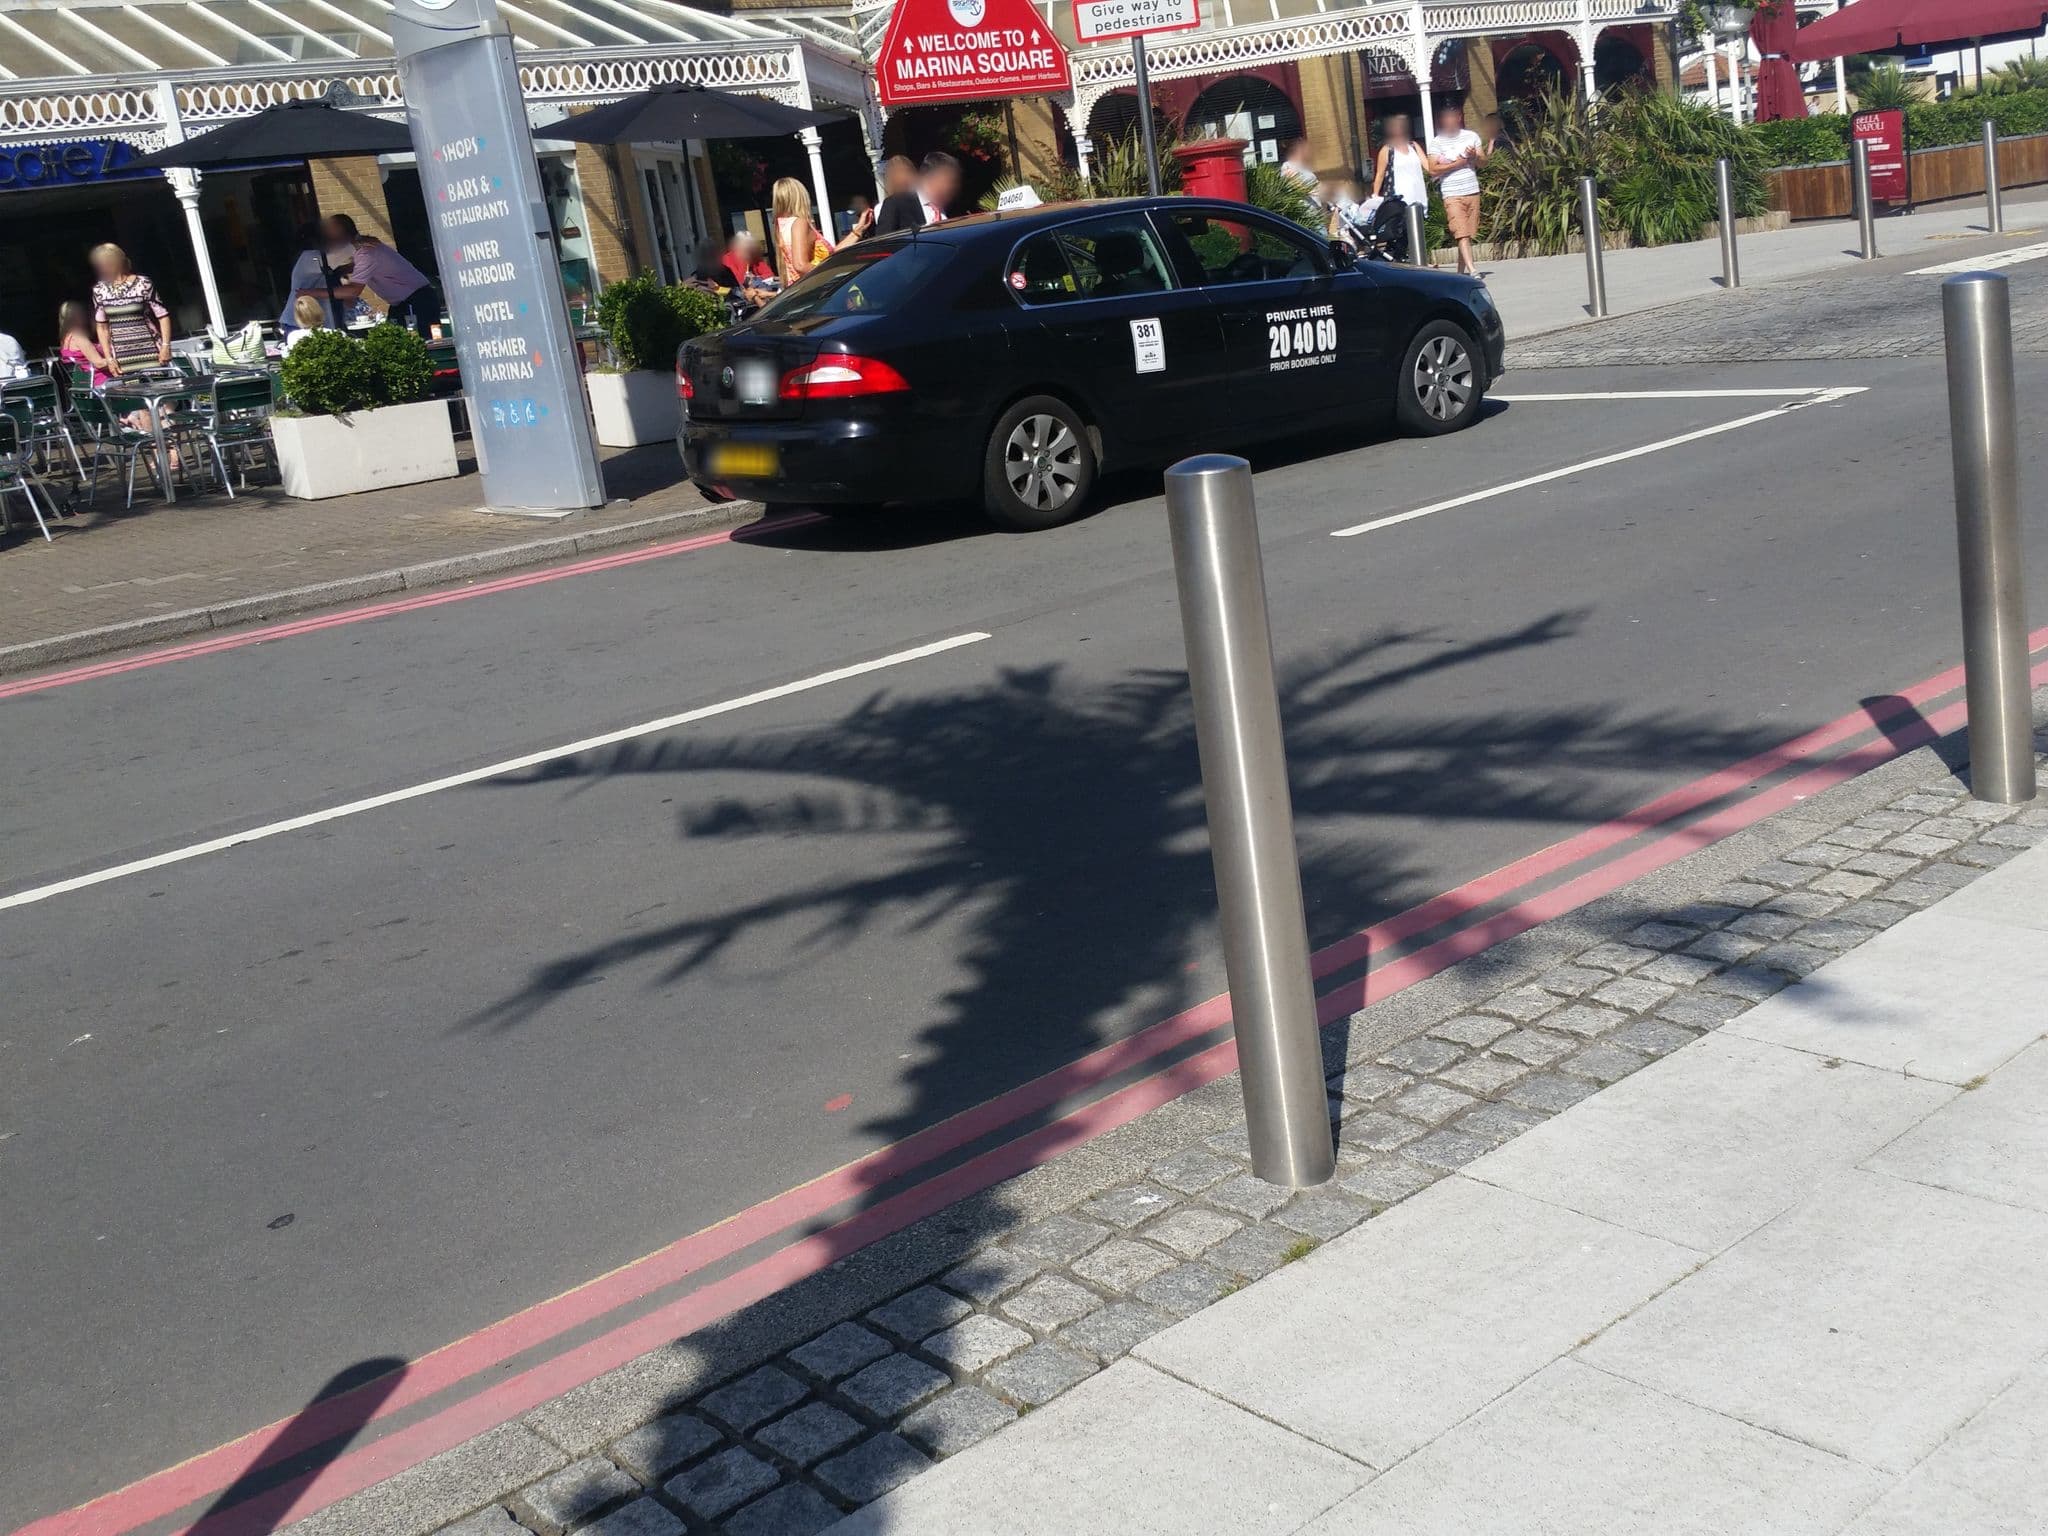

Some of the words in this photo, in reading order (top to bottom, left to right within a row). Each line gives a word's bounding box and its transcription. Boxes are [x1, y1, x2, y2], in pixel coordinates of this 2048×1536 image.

[1092, 4, 1125, 17] Give
[1131, 0, 1159, 11] way
[1095, 11, 1183, 34] pedestrians
[918, 35, 1002, 53] WELCOME
[1003, 29, 1025, 48] TO
[896, 54, 976, 80] MARINA
[978, 48, 1056, 73] SQUARE
[1367, 56, 1408, 75] NAPO
[1856, 121, 1884, 132] NAPOLI
[442, 136, 478, 162] SHOPS
[447, 178, 479, 202] BARS
[480, 175, 490, 194] &
[1000, 191, 1024, 207] 204060
[440, 199, 510, 228] RESTAURANTS
[462, 239, 500, 263] INNER
[458, 262, 516, 288] HARBOUR
[474, 300, 514, 324] HOTEL
[1266, 308, 1308, 323] PRIVATE
[1309, 304, 1334, 317] HIRE
[1137, 323, 1156, 338] 381
[1269, 324, 1291, 359] 20
[1294, 321, 1314, 354] 40
[1316, 318, 1337, 352] 60
[476, 337, 528, 360] PREMIER
[480, 361, 534, 383] MARINAS
[1270, 360, 1290, 372] PRIOR
[1291, 355, 1320, 369] BOOKING
[1320, 353, 1337, 364] ONLY
